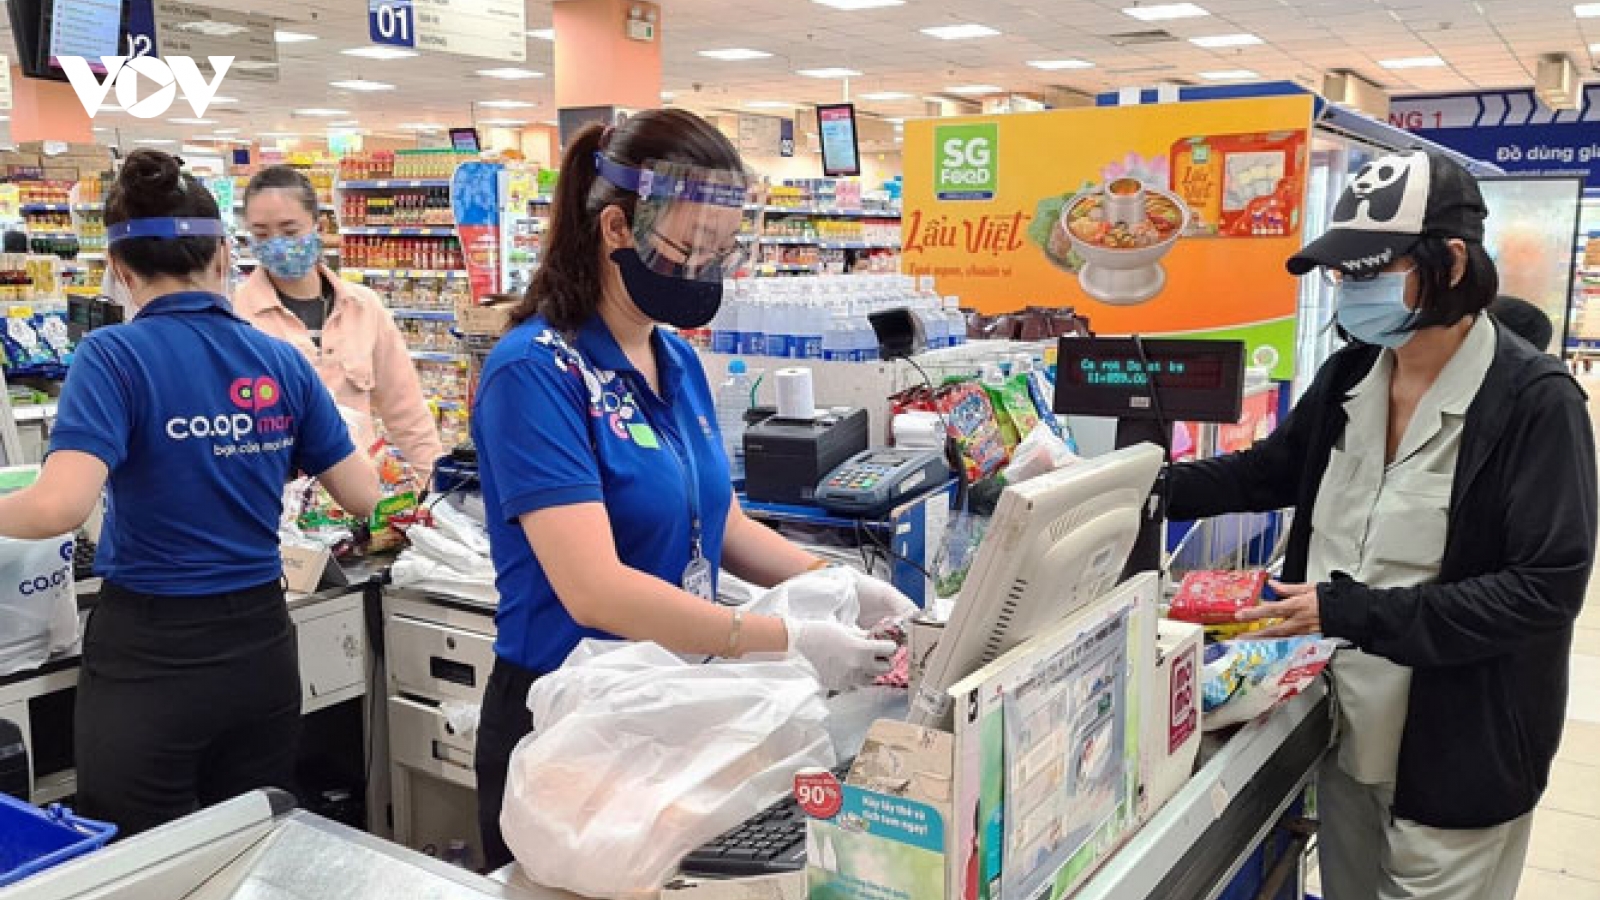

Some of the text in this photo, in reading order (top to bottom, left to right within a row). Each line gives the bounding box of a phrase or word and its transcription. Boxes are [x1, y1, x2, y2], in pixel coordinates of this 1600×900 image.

[377, 4, 409, 40] 01
[126, 32, 152, 58] 2
[1430, 110, 1443, 130] 1
[943, 137, 991, 168] SG
[1496, 144, 1522, 161] Đồ
[1527, 144, 1575, 163] dùng
[962, 208, 1031, 258] Việt
